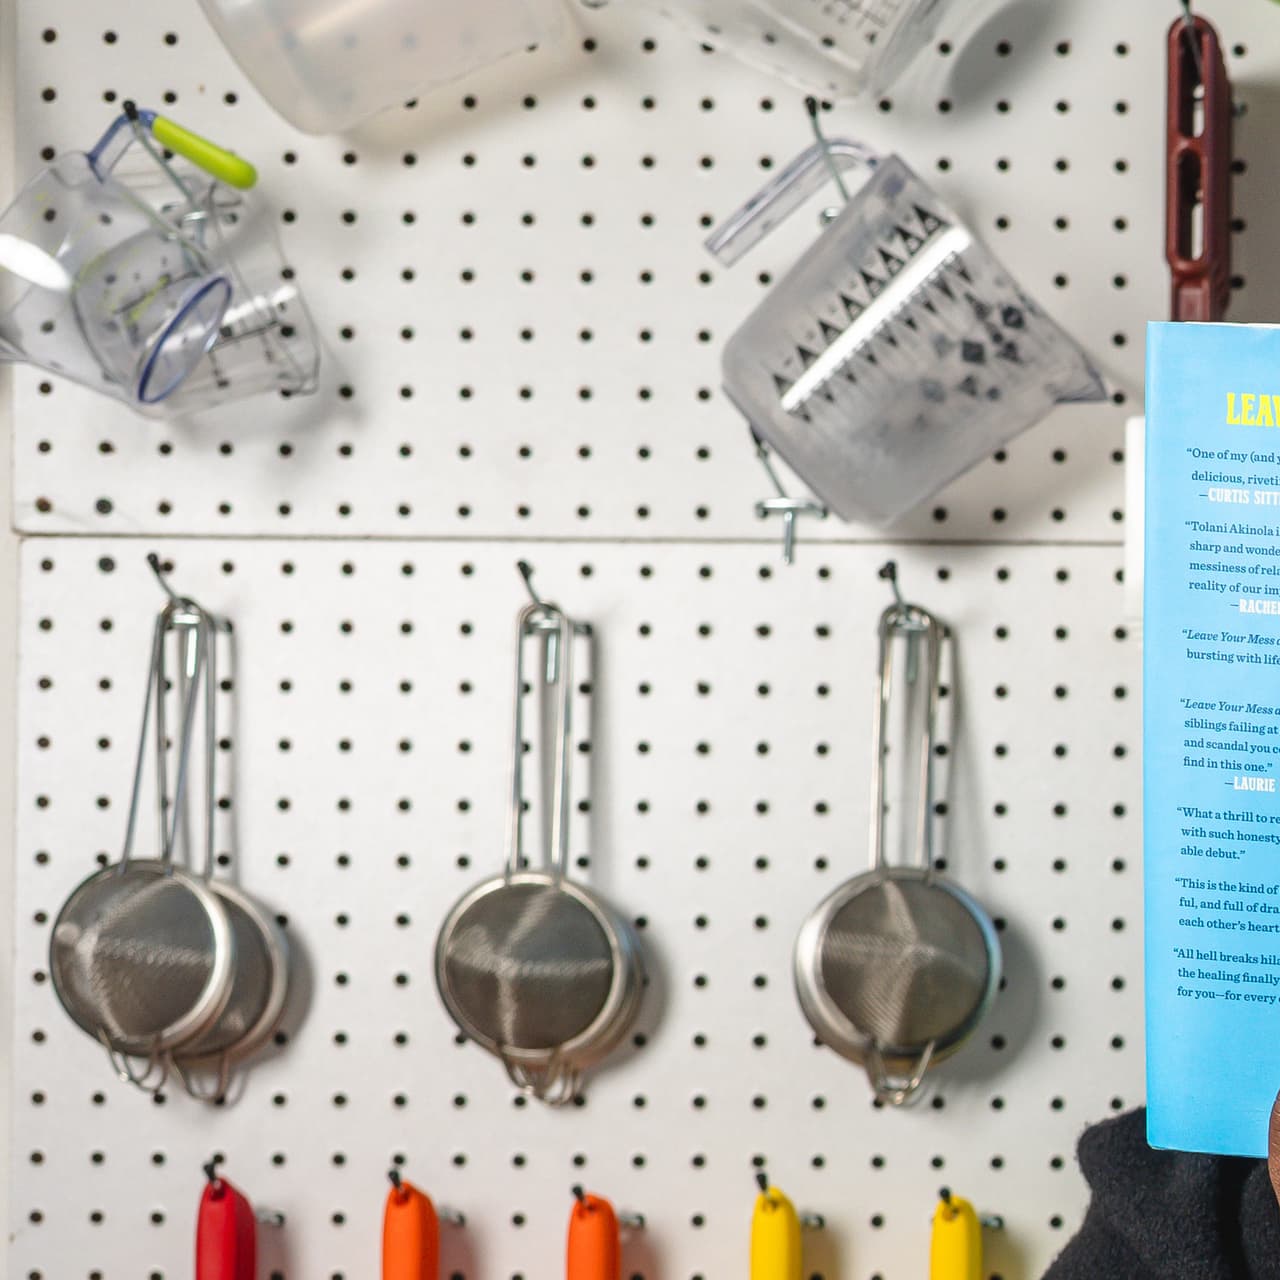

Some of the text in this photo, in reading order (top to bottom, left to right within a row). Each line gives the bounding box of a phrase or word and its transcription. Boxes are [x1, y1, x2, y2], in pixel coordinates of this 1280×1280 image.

[1217, 450, 1230, 459] of
[1230, 453, 1247, 462] my
[1250, 452, 1274, 463] (and
[1191, 471, 1246, 485] delicious,
